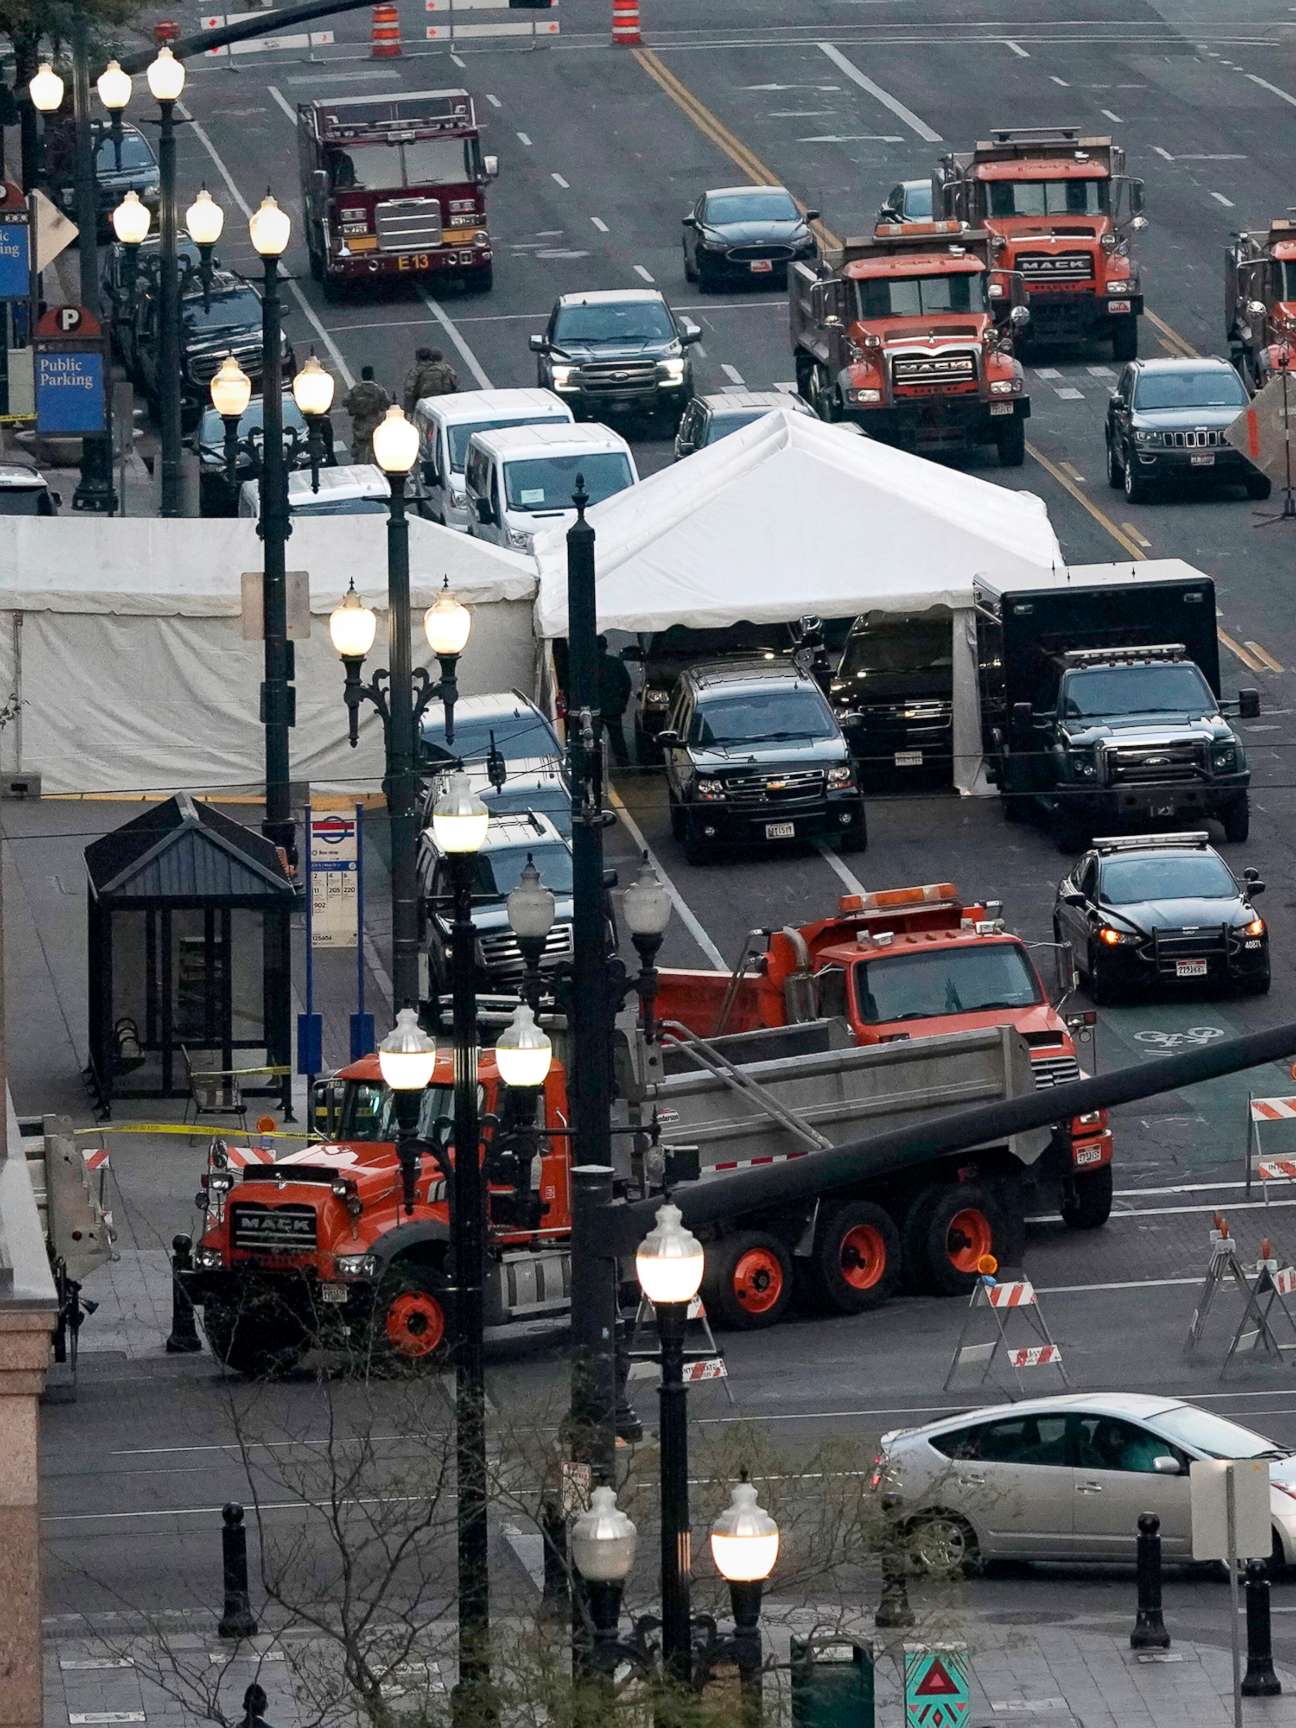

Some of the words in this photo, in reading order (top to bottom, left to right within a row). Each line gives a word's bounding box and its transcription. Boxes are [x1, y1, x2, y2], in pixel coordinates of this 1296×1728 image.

[412, 253, 429, 269] 13
[1022, 260, 1084, 270] MACK
[62, 308, 80, 331] P
[40, 357, 82, 372] Public
[897, 360, 974, 373] MACK
[40, 373, 93, 389] Parking
[241, 1217, 310, 1231] MACK
